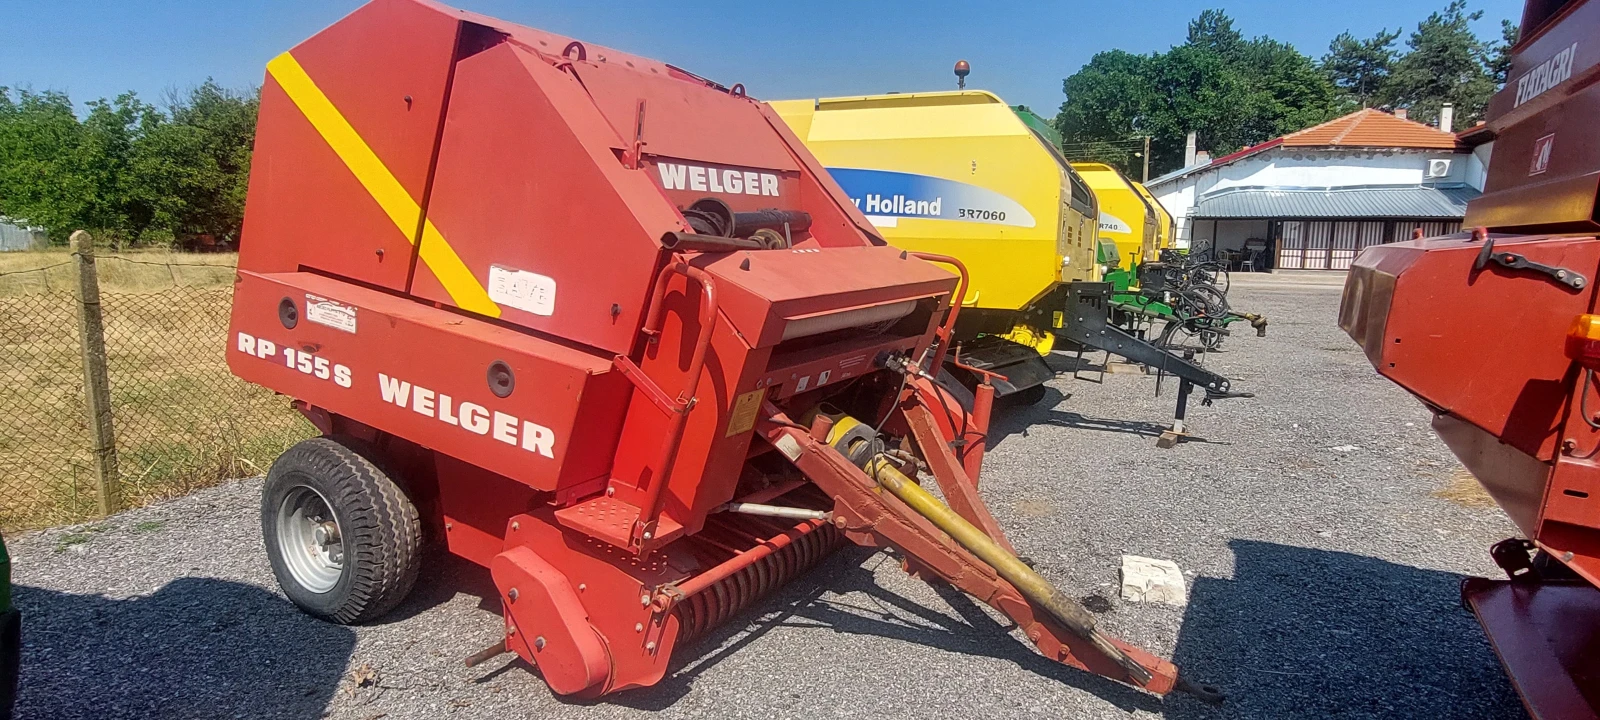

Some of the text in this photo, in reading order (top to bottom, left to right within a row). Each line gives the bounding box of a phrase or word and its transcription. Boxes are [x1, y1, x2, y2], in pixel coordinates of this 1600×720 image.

[1513, 42, 1578, 109] FIATAGRI
[657, 162, 780, 197] WELGER
[866, 194, 942, 216] Holland
[958, 208, 1006, 222] BR7060
[238, 331, 276, 359] RP
[378, 372, 555, 459] WELGER
